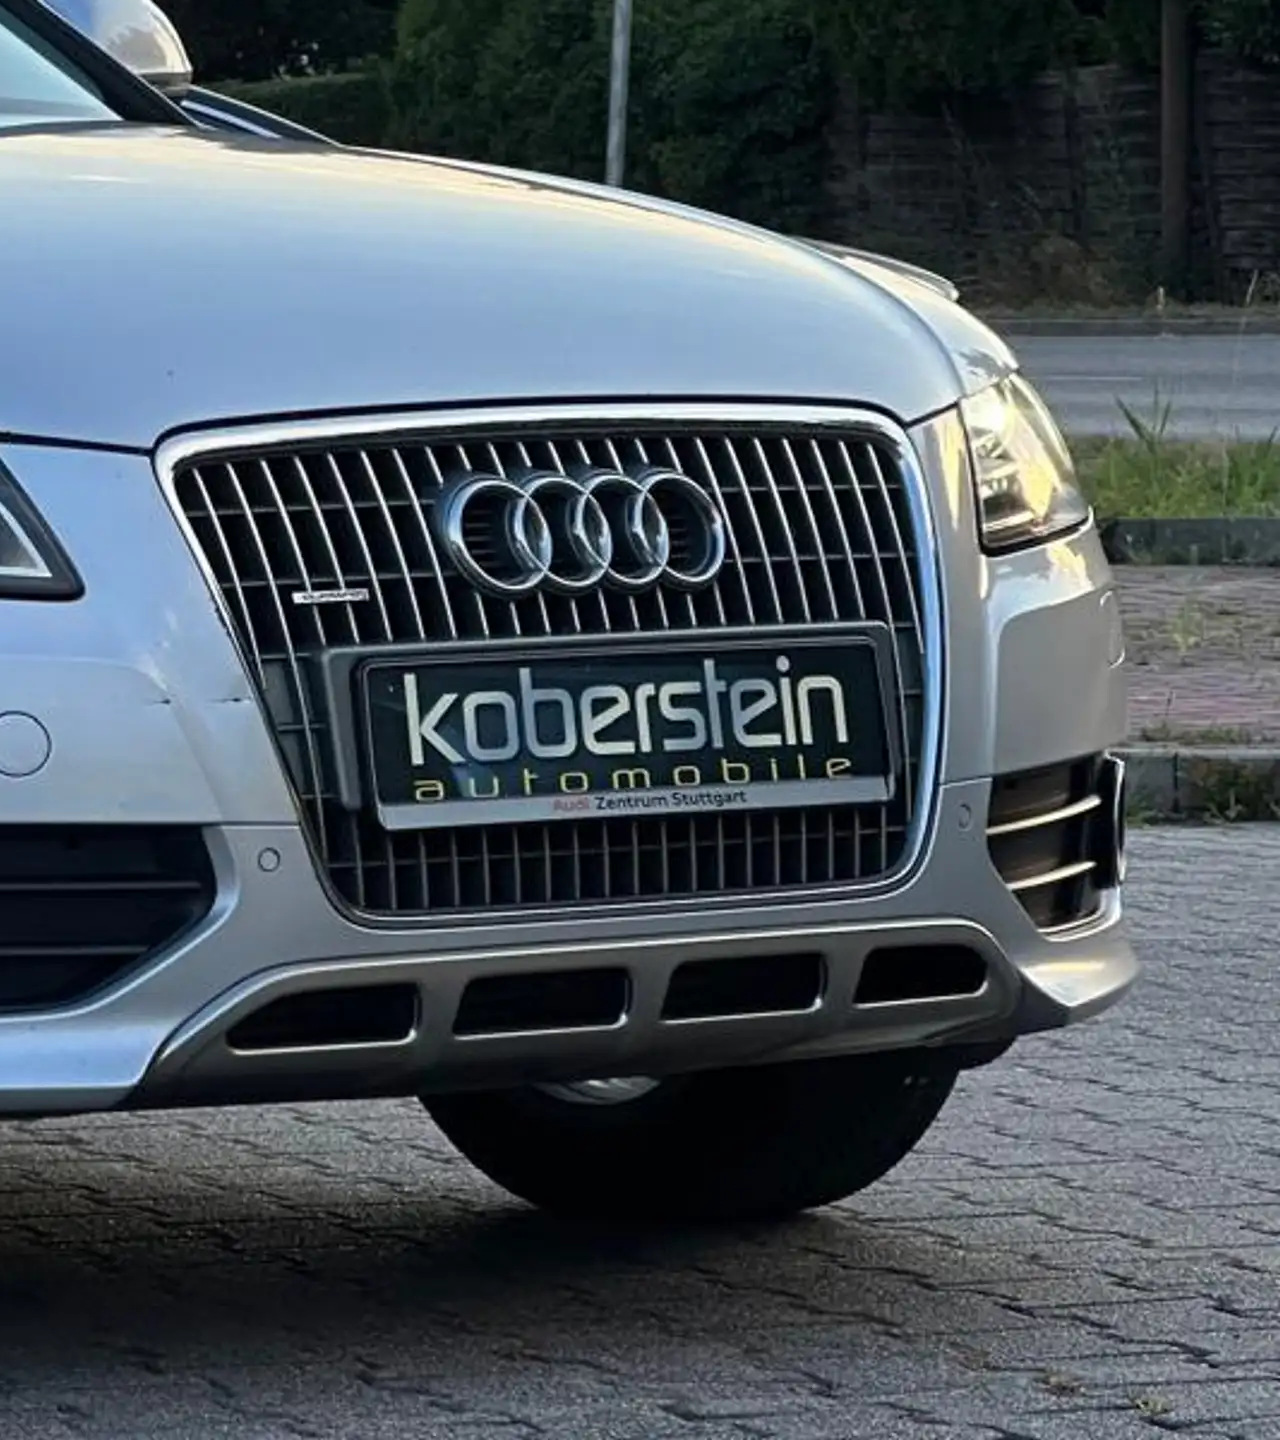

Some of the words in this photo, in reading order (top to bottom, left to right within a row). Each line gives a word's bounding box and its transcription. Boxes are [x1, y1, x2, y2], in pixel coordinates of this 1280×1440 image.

[403, 655, 849, 767] koberstein
[413, 753, 853, 802] automobile
[554, 796, 589, 811] Audi
[595, 792, 669, 810] Zentrum
[672, 789, 747, 807] Stuttgart
